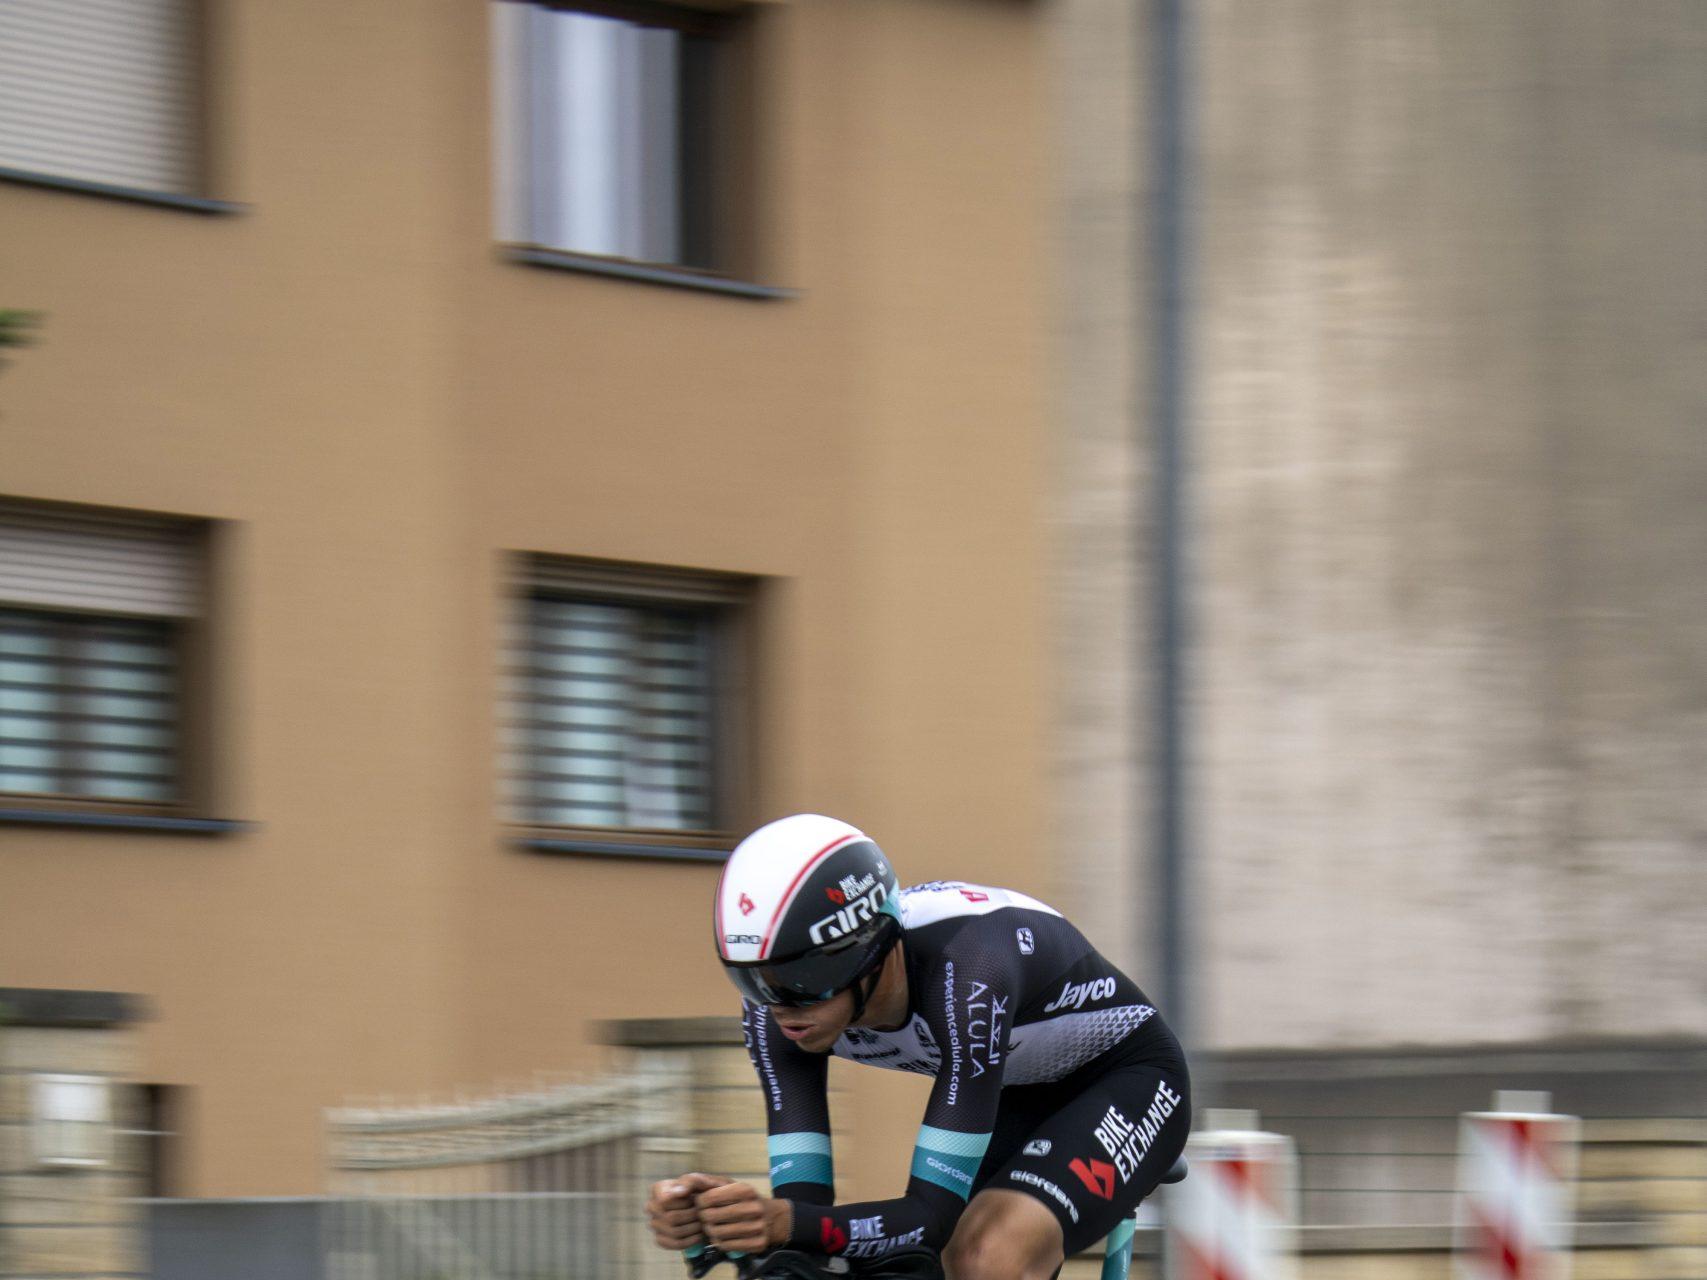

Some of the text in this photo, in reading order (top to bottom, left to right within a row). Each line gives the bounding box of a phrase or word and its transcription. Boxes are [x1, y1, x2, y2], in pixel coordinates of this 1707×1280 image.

[725, 934, 762, 945] GIRO
[809, 882, 888, 945] GIRO
[1043, 976, 1117, 1013] Jayco
[944, 961, 963, 1105] experiencealula.com
[966, 981, 989, 1079] ALULA
[1094, 1105, 1135, 1158] BIKE
[1114, 1079, 1182, 1185] EXCHANGE
[849, 1215, 886, 1240] BIKE
